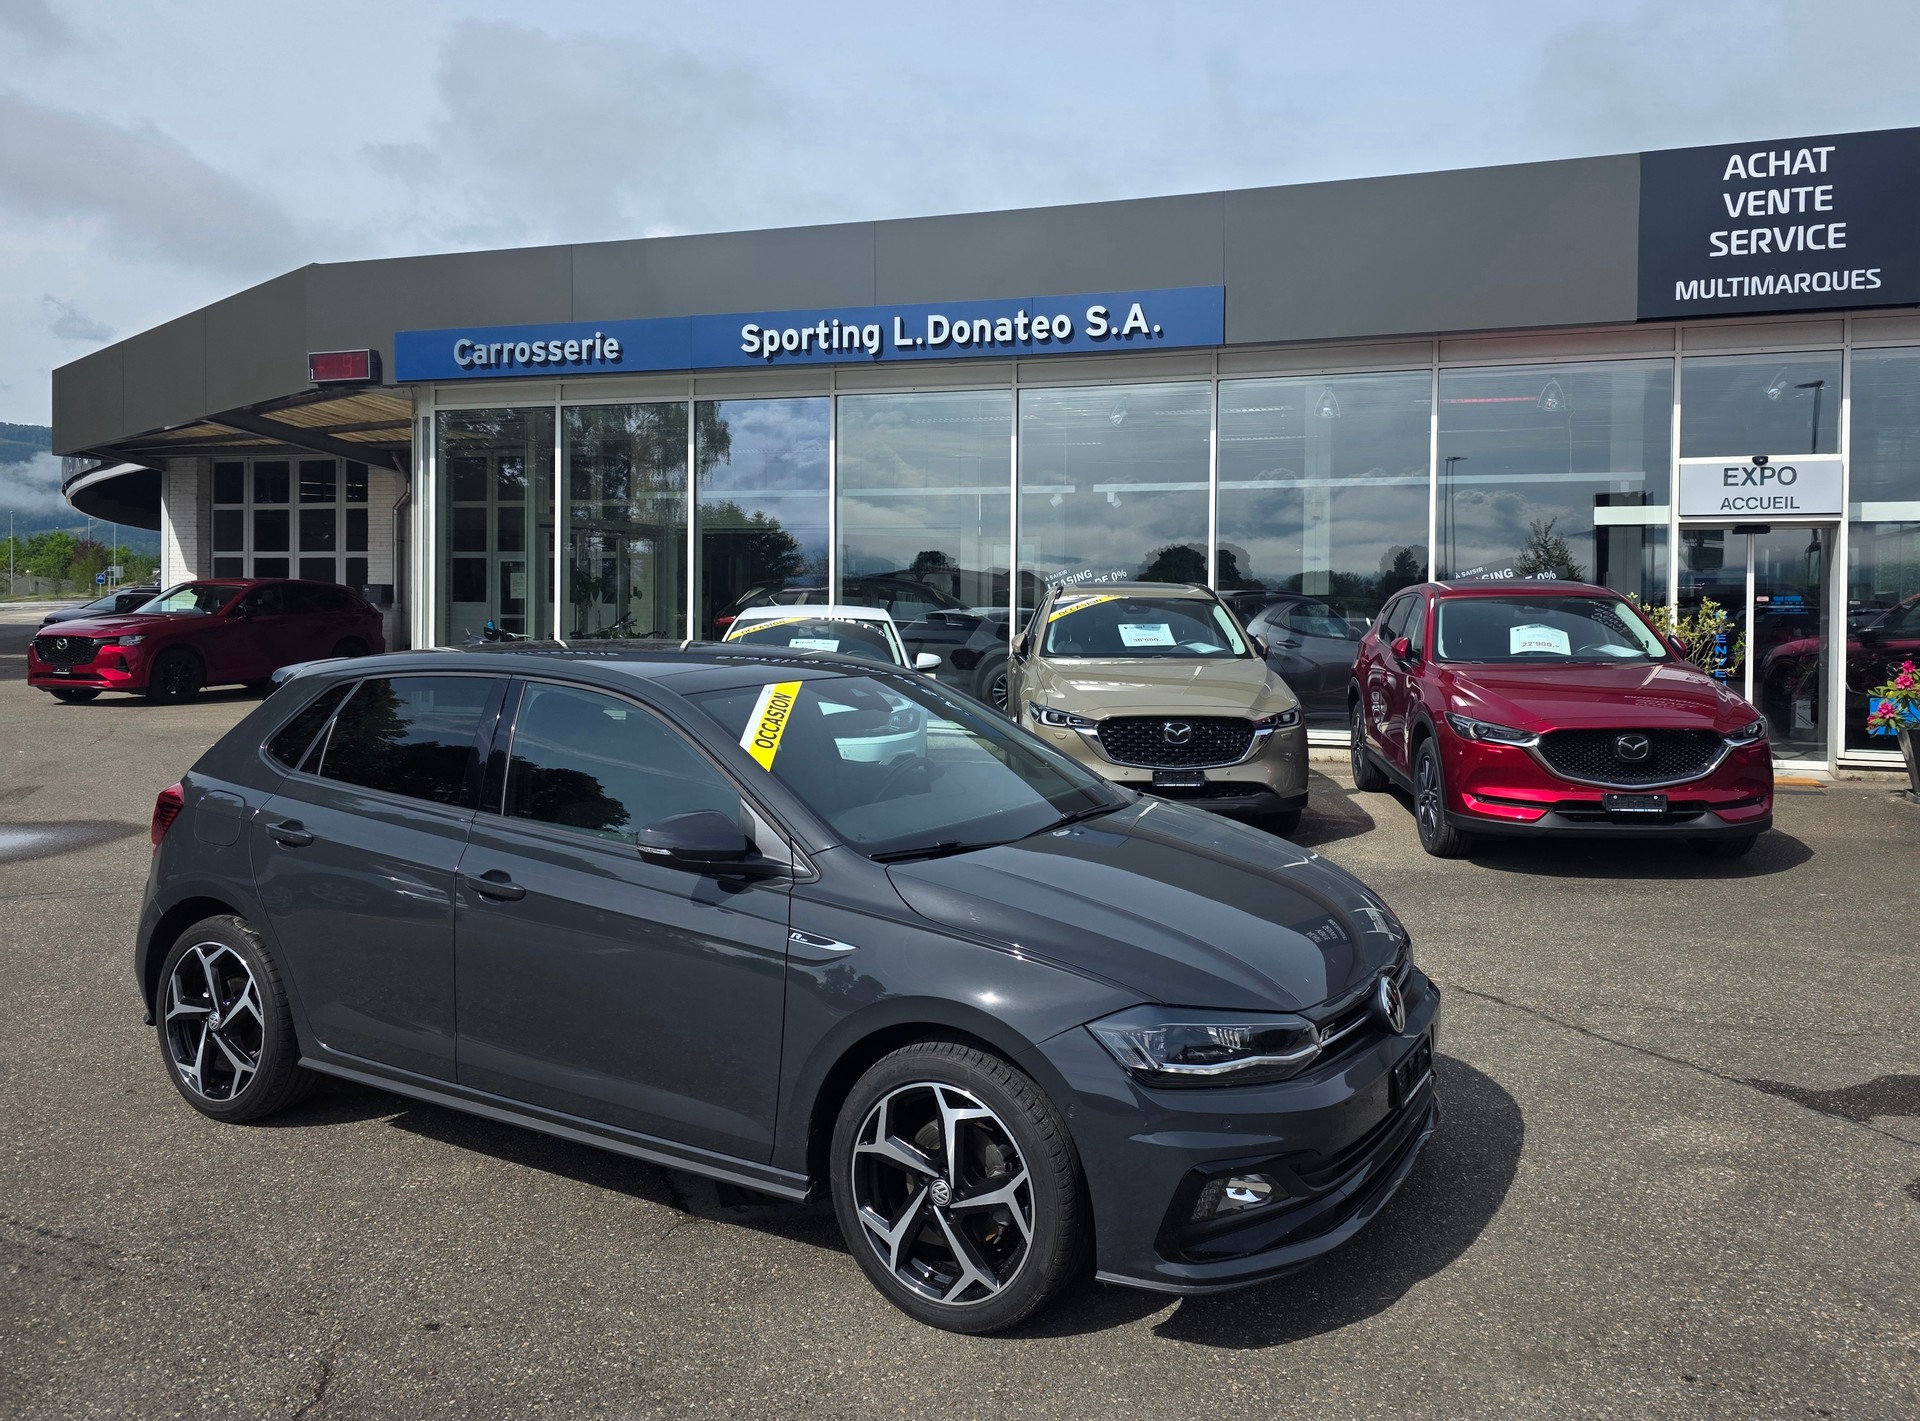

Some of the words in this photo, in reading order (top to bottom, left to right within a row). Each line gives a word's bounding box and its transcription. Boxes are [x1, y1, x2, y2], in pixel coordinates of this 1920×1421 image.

[1723, 146, 1835, 180] ACHAT
[1723, 185, 1833, 218] VENTE
[1709, 222, 1846, 257] SERVICE
[1675, 268, 1882, 301] MULTIMARQUES
[740, 321, 882, 359] Sporting
[893, 311, 1072, 349] L.Donateo
[1085, 303, 1162, 340] S.A.
[452, 331, 622, 367] Carrosserie
[1723, 466, 1797, 487] EXPO
[1720, 496, 1800, 511] ACCUEIL
[755, 692, 793, 750] OCCASION
